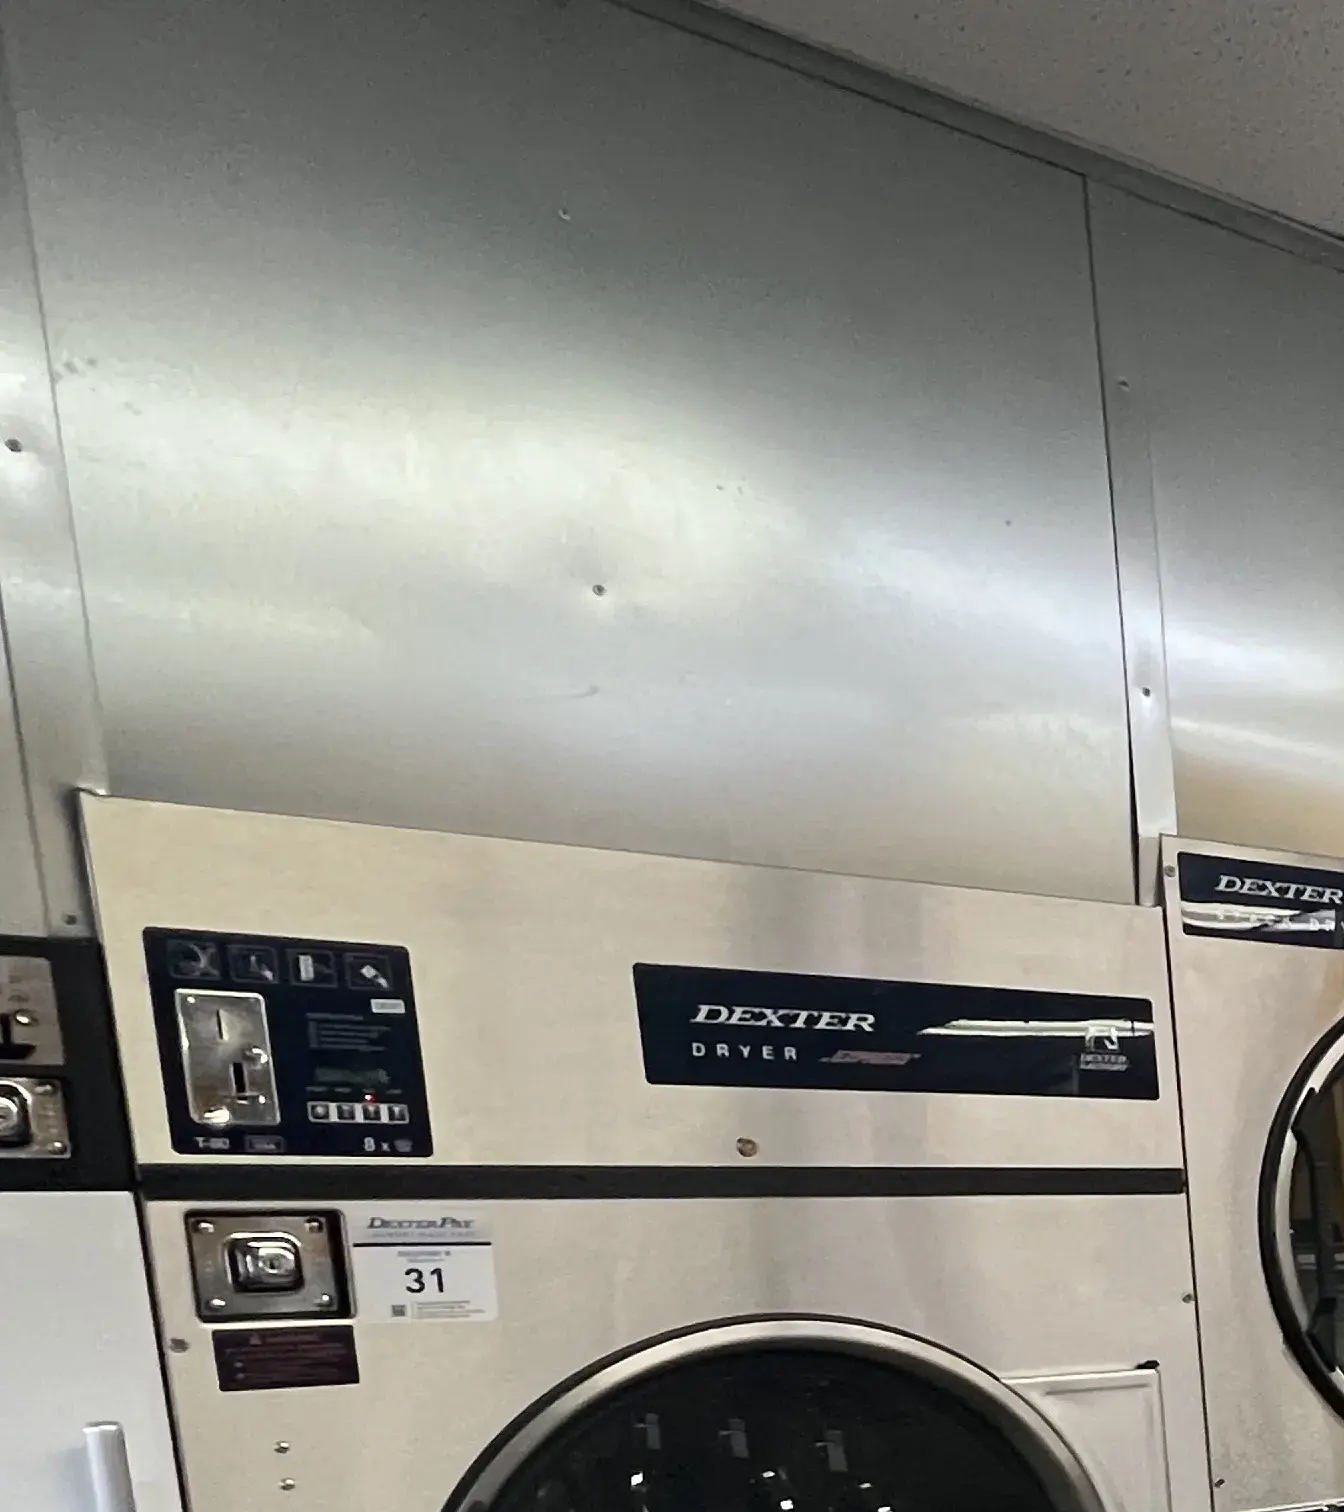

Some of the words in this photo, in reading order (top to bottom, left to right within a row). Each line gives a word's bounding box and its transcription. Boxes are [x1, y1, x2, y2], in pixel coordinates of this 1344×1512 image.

[1214, 874, 1344, 904] DEXTER
[689, 1004, 876, 1032] DEXTER
[691, 1042, 799, 1061] DRYER
[404, 1267, 445, 1294] 31
